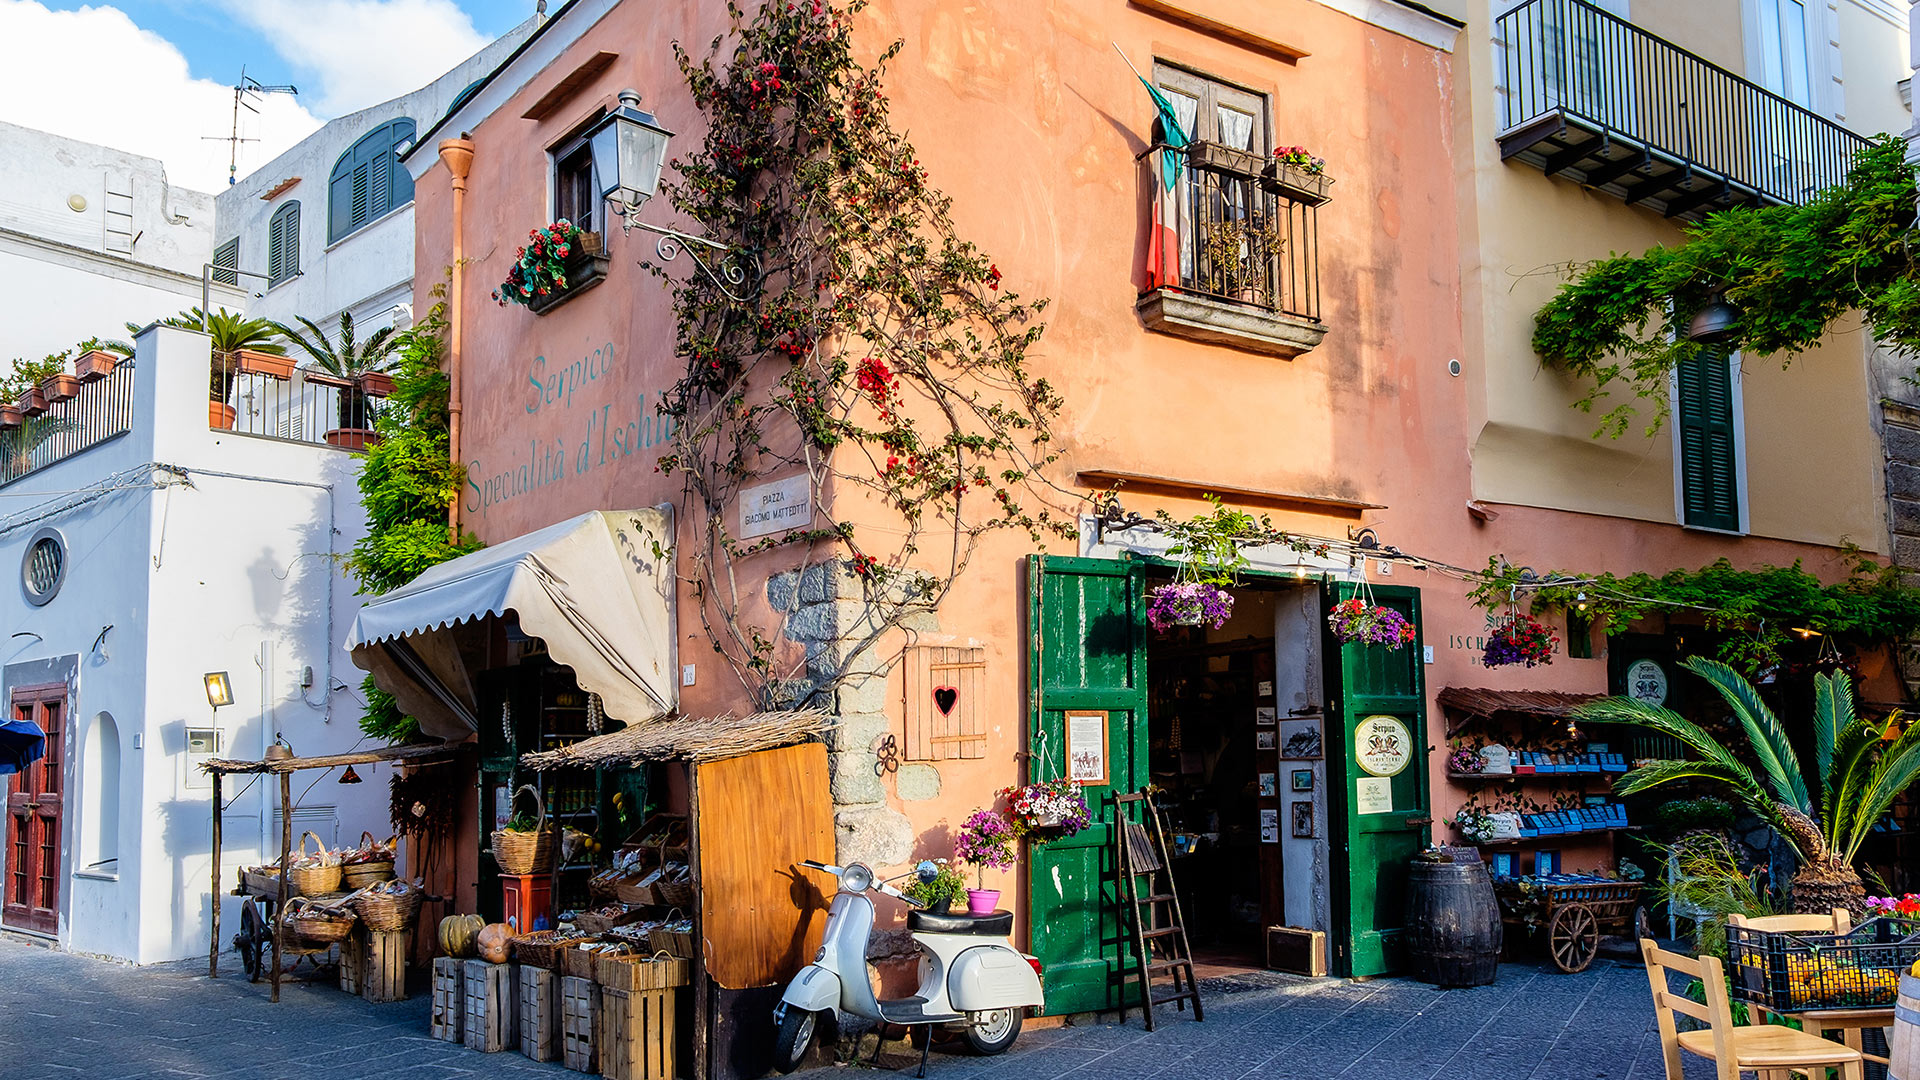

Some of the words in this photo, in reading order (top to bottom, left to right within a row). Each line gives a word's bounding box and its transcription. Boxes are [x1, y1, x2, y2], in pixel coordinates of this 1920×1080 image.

[526, 336, 614, 414] Serpico
[466, 438, 565, 519] Specialità
[762, 491, 785, 505] PIAZZA
[745, 511, 770, 525] GIACOMO
[772, 503, 807, 519] MATTEOTTI
[1382, 561, 1388, 573] 2
[1450, 634, 1484, 649] ISCH
[1371, 722, 1396, 734] Serpico
